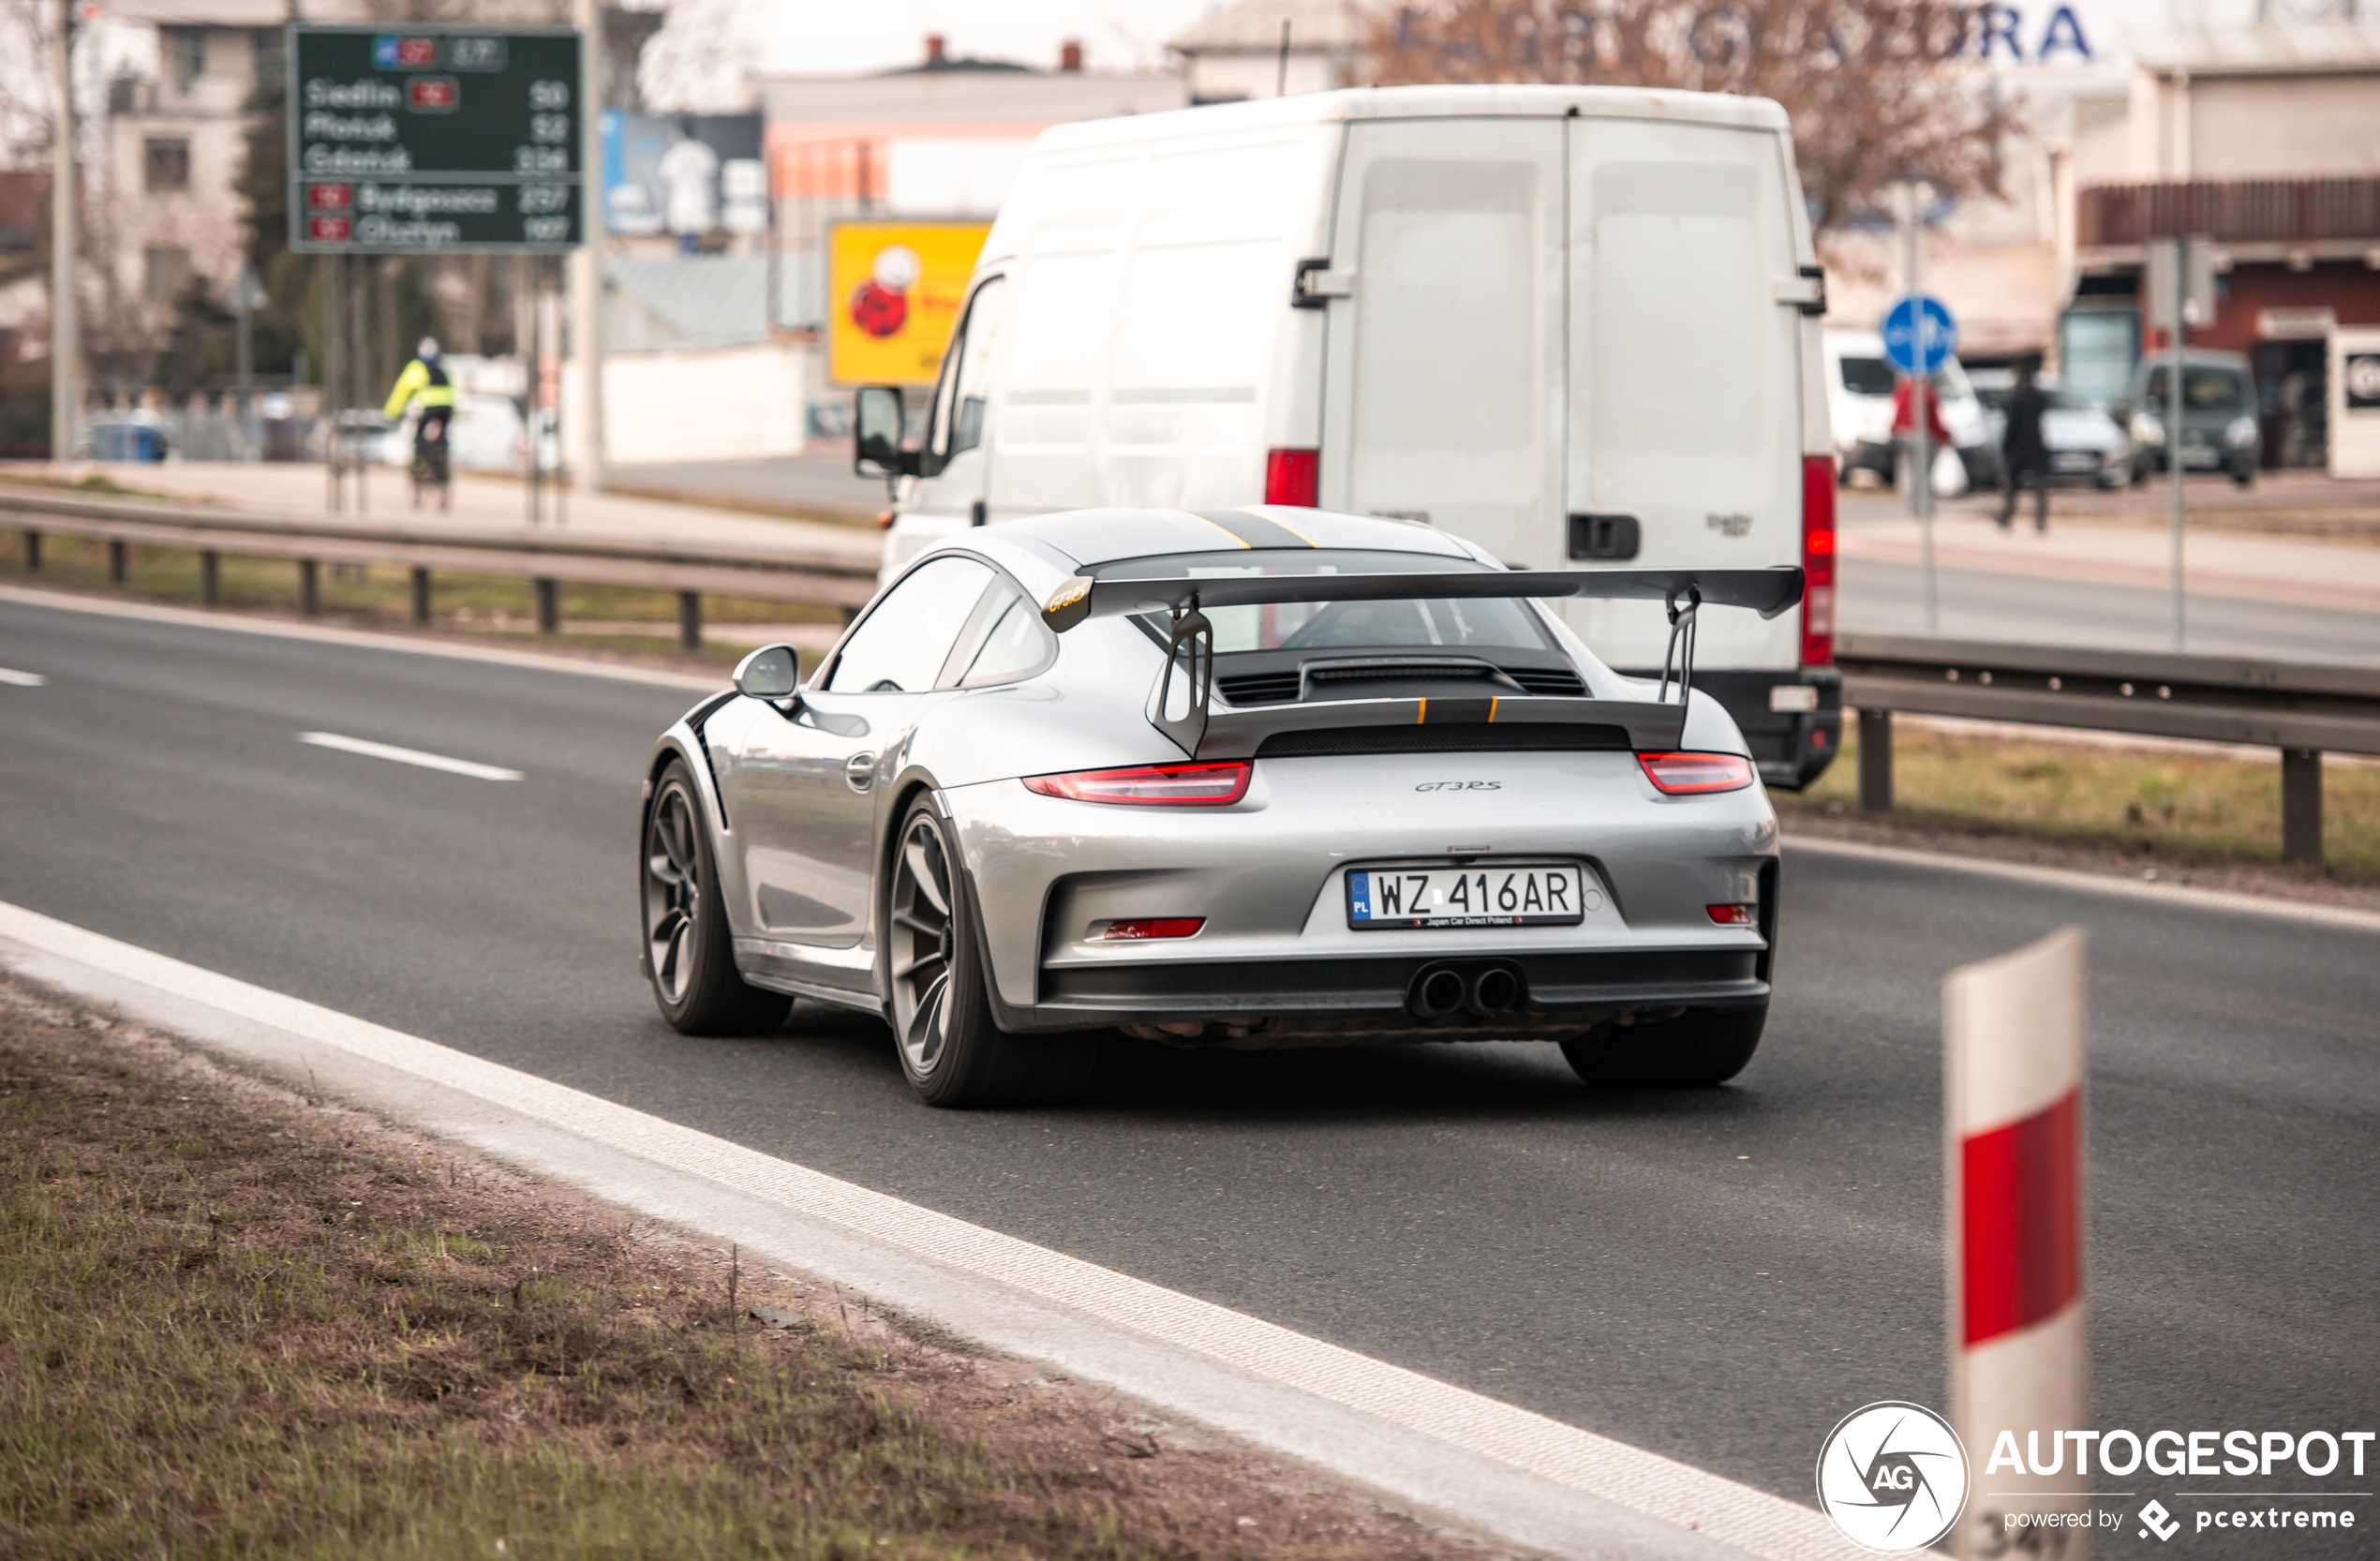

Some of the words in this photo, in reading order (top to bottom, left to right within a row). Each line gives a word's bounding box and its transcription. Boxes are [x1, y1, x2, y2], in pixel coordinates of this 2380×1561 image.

[1378, 875, 1432, 915] WZ
[1449, 873, 1569, 914] 416AR
[1354, 902, 1368, 914] PL
[1427, 918, 1450, 927] Japan
[1488, 916, 1512, 925] Poland
